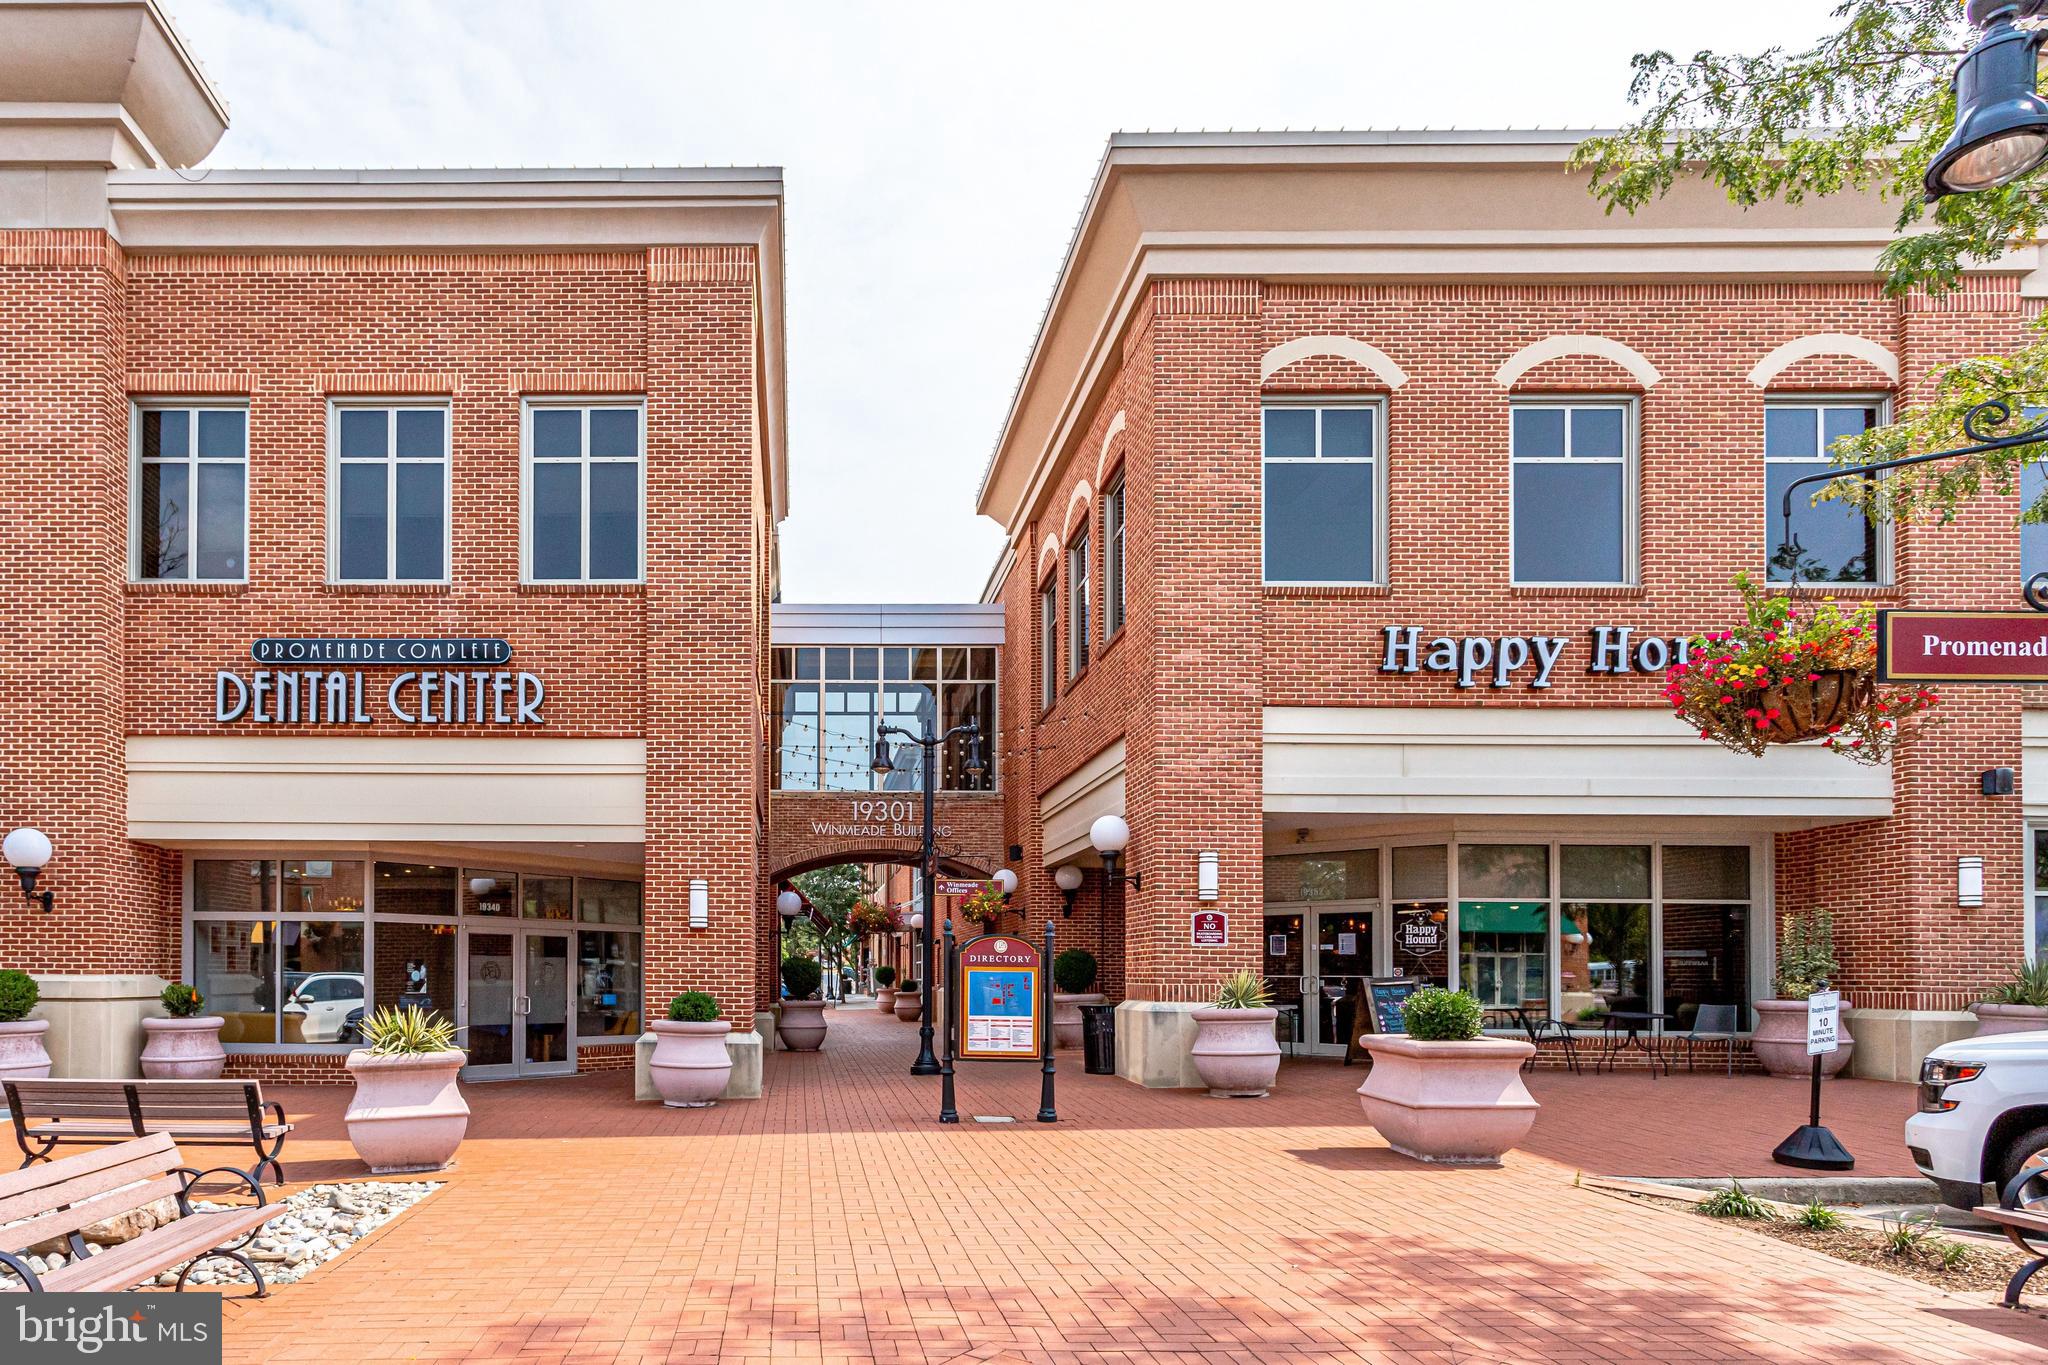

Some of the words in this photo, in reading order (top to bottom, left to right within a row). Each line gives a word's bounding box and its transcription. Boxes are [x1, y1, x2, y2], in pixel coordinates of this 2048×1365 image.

[260, 642, 386, 660] PROMENADE
[396, 642, 502, 660] COMPLETE
[1381, 626, 1570, 687] Happy
[216, 671, 373, 723] DENTAL
[388, 671, 545, 723] CENTER
[851, 801, 913, 822] 19301
[894, 822, 952, 837] BUILNG
[479, 902, 501, 912] 19340
[1405, 924, 1438, 936] Happy
[1405, 934, 1438, 944] Hound
[969, 954, 1032, 963] DIRECTORY
[1819, 1017, 1828, 1027] 10
[1812, 1027, 1833, 1036] MINUTE
[1810, 1035, 1835, 1044] PARKING
